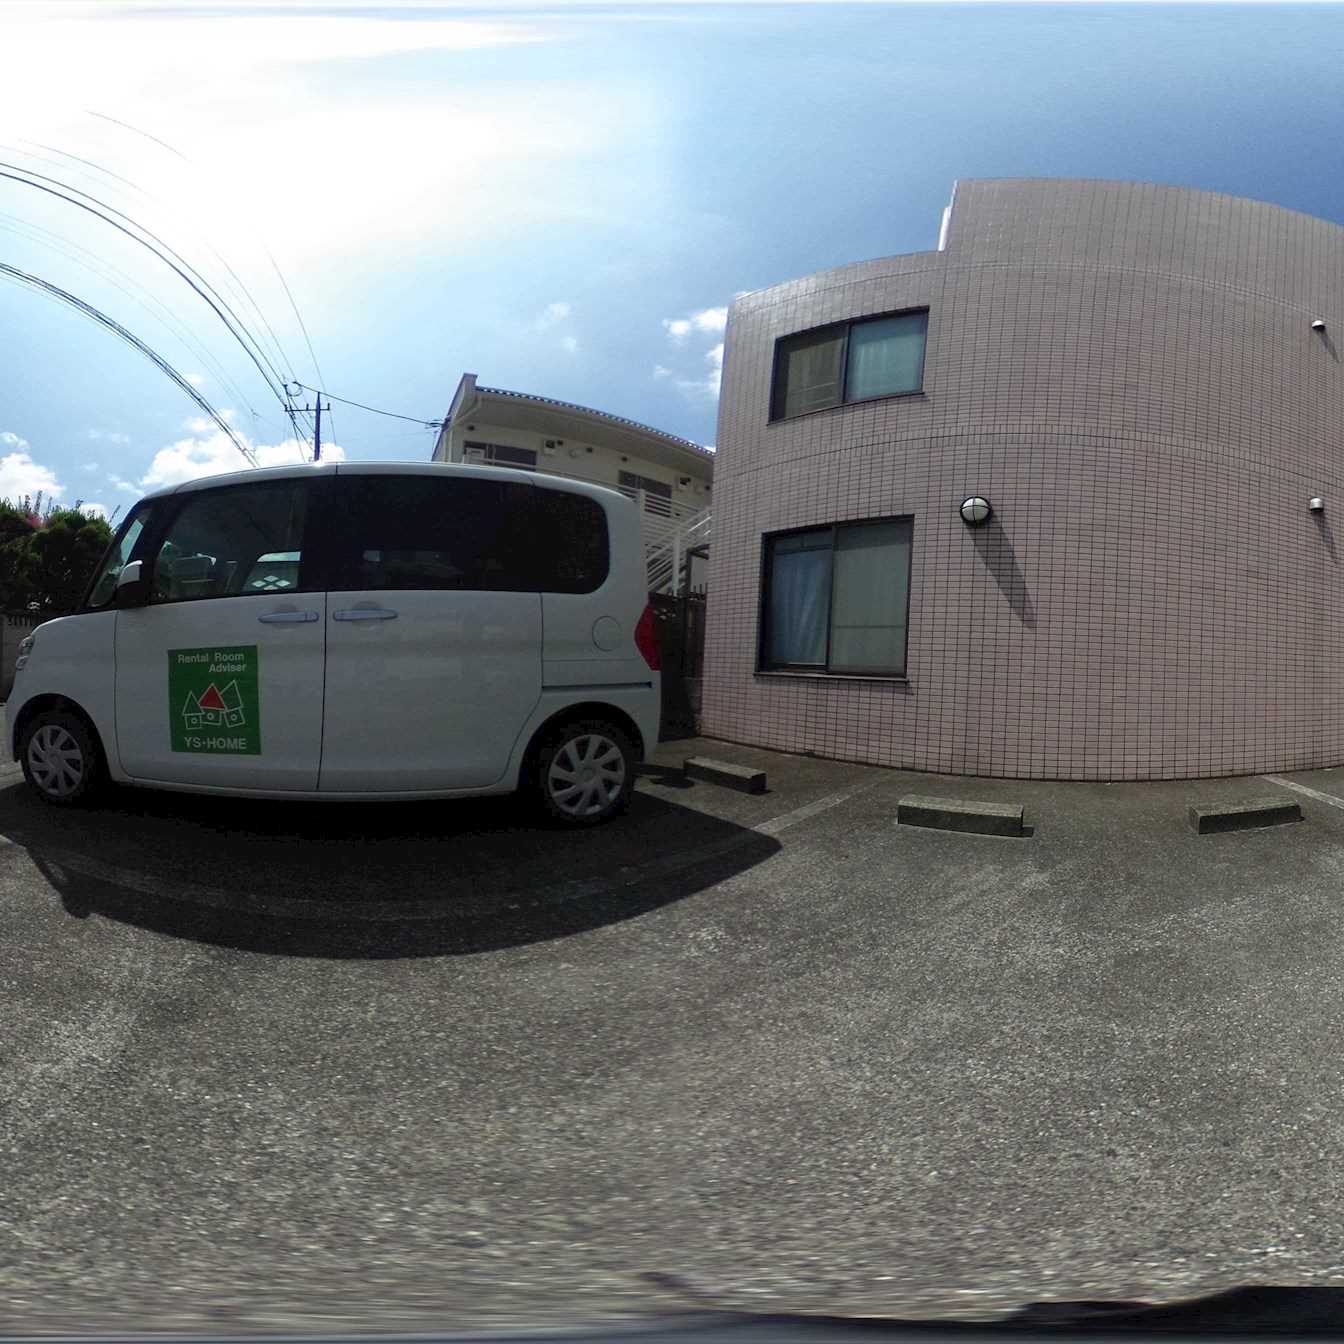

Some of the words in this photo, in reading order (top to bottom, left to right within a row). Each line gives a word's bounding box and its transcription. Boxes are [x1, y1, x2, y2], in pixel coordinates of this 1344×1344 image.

[177, 653, 209, 664] Rental
[214, 652, 245, 662] Room
[208, 663, 247, 673] Adviser
